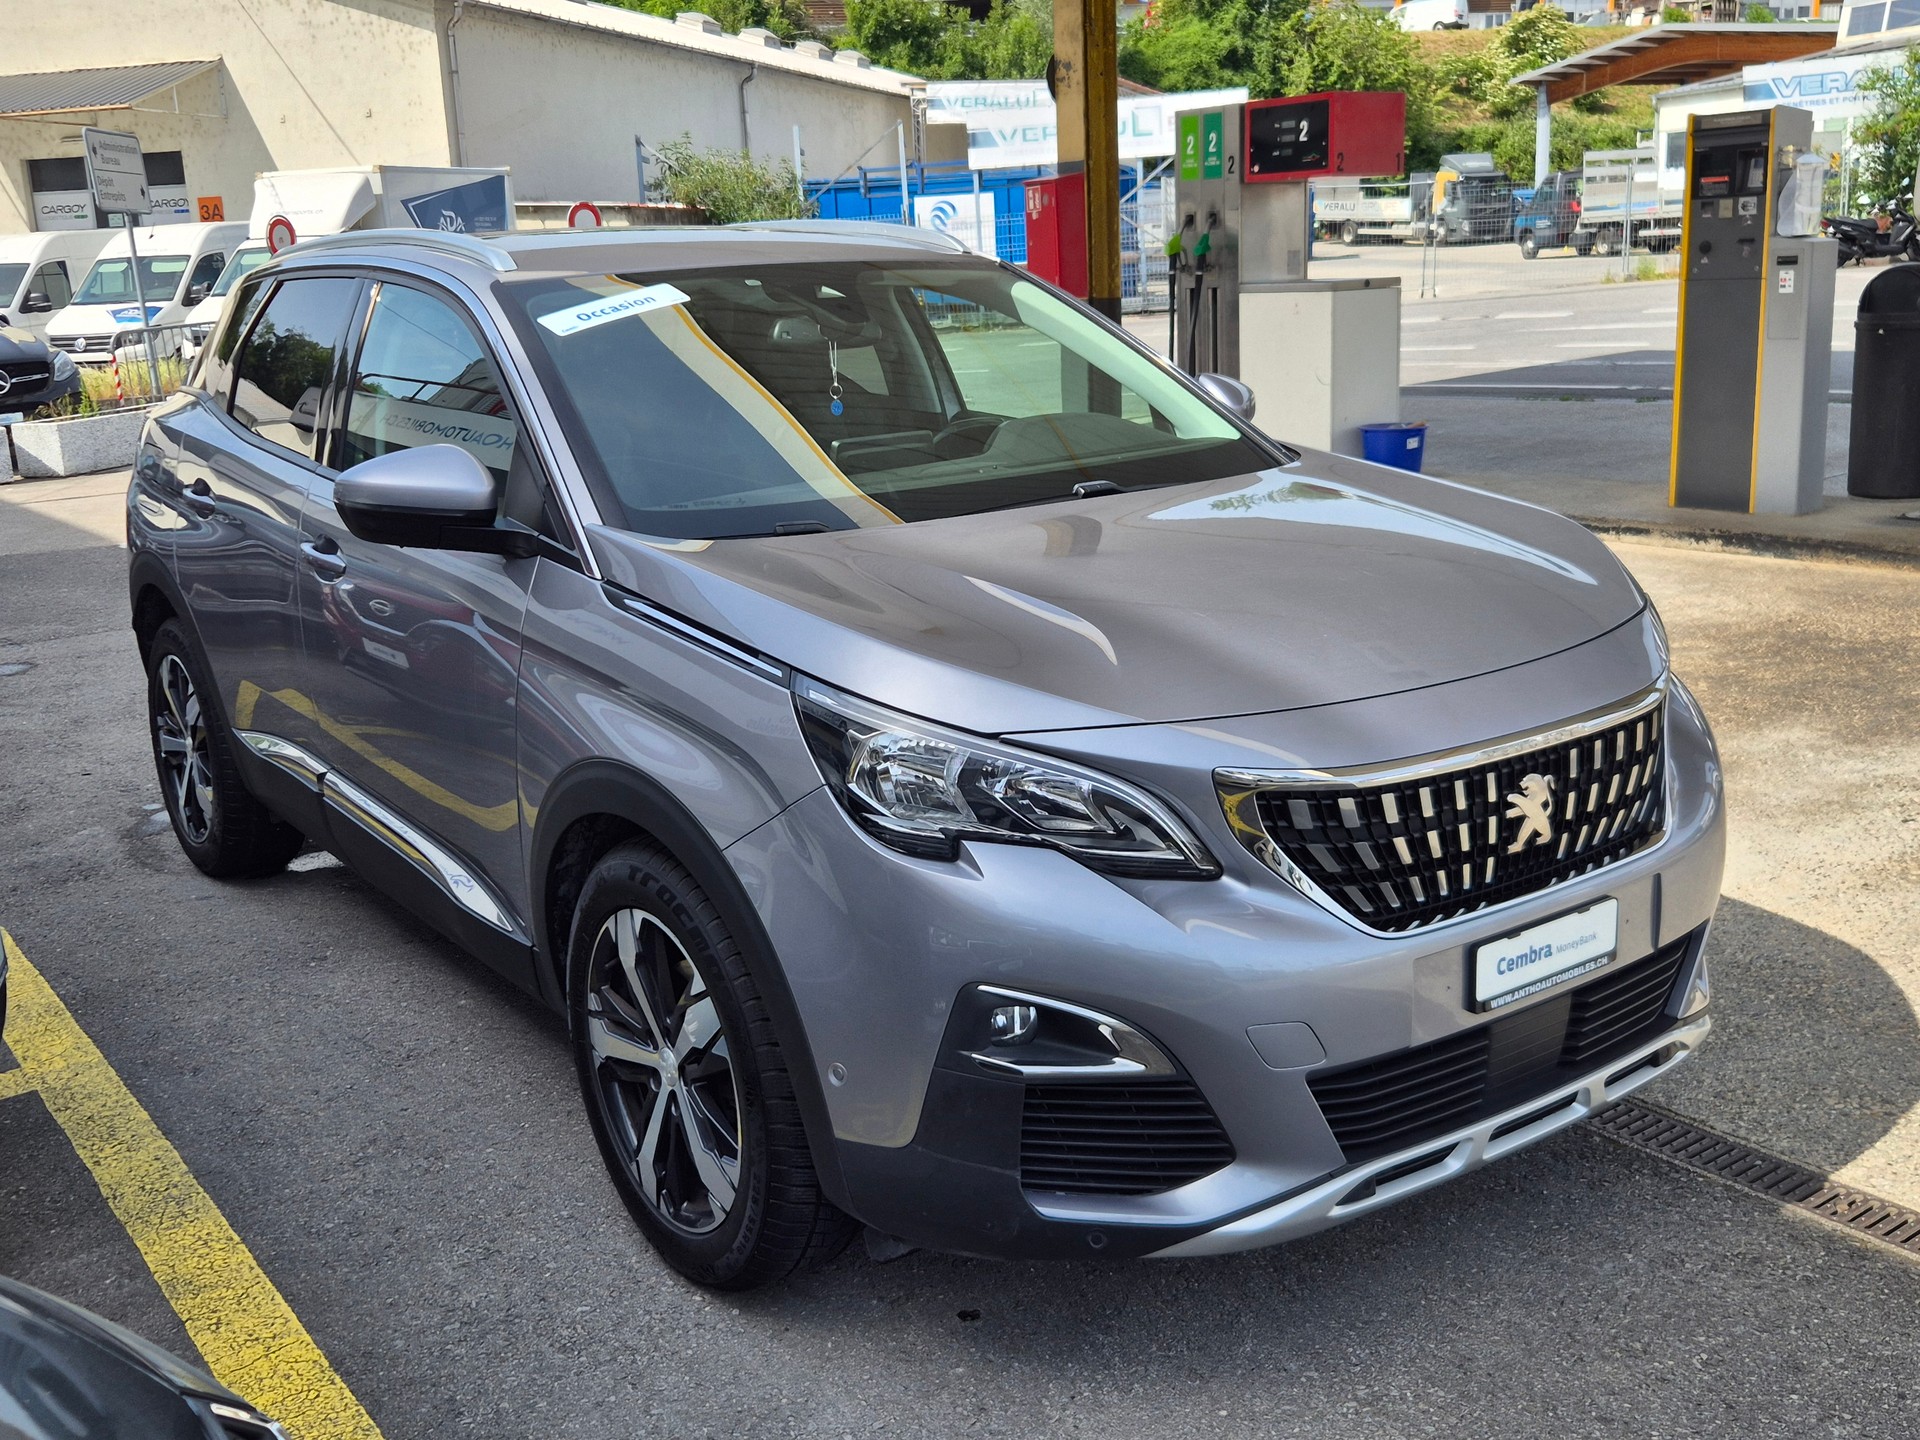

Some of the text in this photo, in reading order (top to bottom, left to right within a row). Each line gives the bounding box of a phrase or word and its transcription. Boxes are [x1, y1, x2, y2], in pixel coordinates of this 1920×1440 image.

[1299, 120, 1308, 141] 2
[1186, 135, 1195, 155] 2
[1208, 132, 1217, 153] 2
[1227, 155, 1235, 175] 2
[1336, 152, 1344, 172] 2
[41, 203, 87, 214] CARGOY
[200, 204, 223, 221] 3A
[1323, 202, 1356, 212] VERALU
[576, 296, 657, 322] Occasion
[1496, 931, 1598, 976] Cembra MoneyBank
[1490, 956, 1609, 1009] WWW.ANTHOAUTOMOBILES.CH
